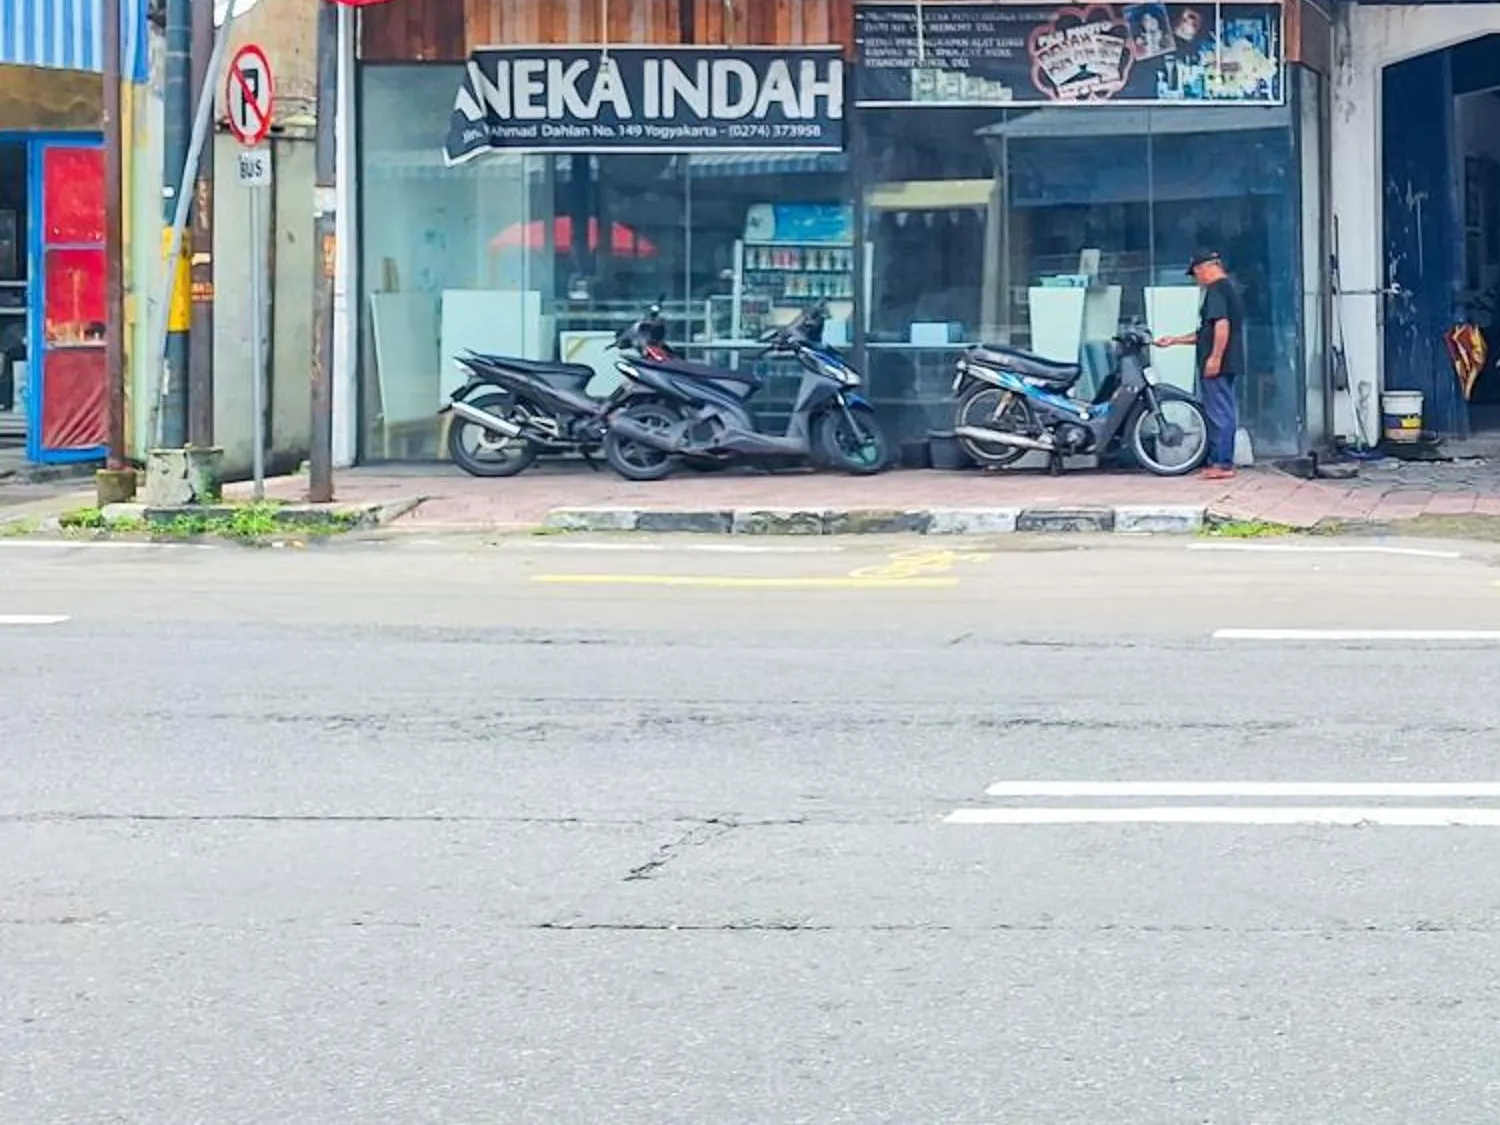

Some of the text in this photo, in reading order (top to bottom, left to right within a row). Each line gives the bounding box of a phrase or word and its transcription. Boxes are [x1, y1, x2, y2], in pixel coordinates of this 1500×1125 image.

[643, 59, 844, 119] INDAH
[541, 125, 590, 137] Dahlan
[593, 125, 616, 137] No.
[618, 125, 642, 137] 149
[645, 125, 718, 139] Yogyakarta
[728, 125, 771, 139] (0274)
